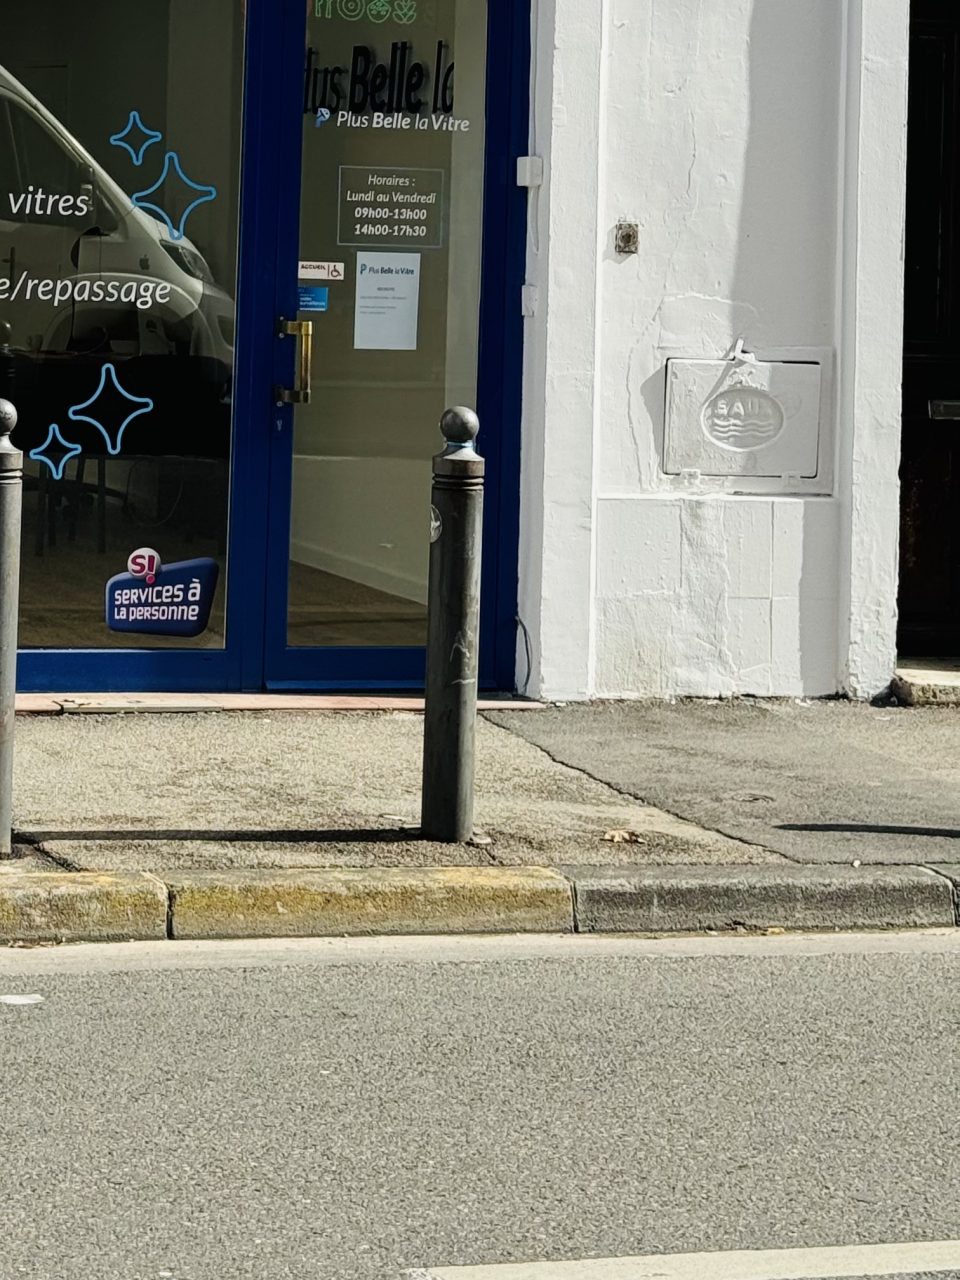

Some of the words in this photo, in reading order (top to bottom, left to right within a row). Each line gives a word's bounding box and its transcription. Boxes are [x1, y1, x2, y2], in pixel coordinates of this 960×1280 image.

[303, 47, 341, 114] lus
[349, 41, 424, 114] Belle
[336, 110, 369, 127] Plus
[372, 111, 411, 129] Belle
[414, 113, 429, 130] la
[431, 113, 470, 132] Vitre
[368, 174, 409, 186] Horaires
[8, 186, 89, 217] vitres
[346, 190, 375, 201] Lundi
[376, 192, 390, 202] au
[391, 191, 437, 204] Vendredi
[354, 207, 427, 220] 09h00-13h00
[354, 224, 427, 237] 14h00-17h30
[187, 578, 201, 601] à
